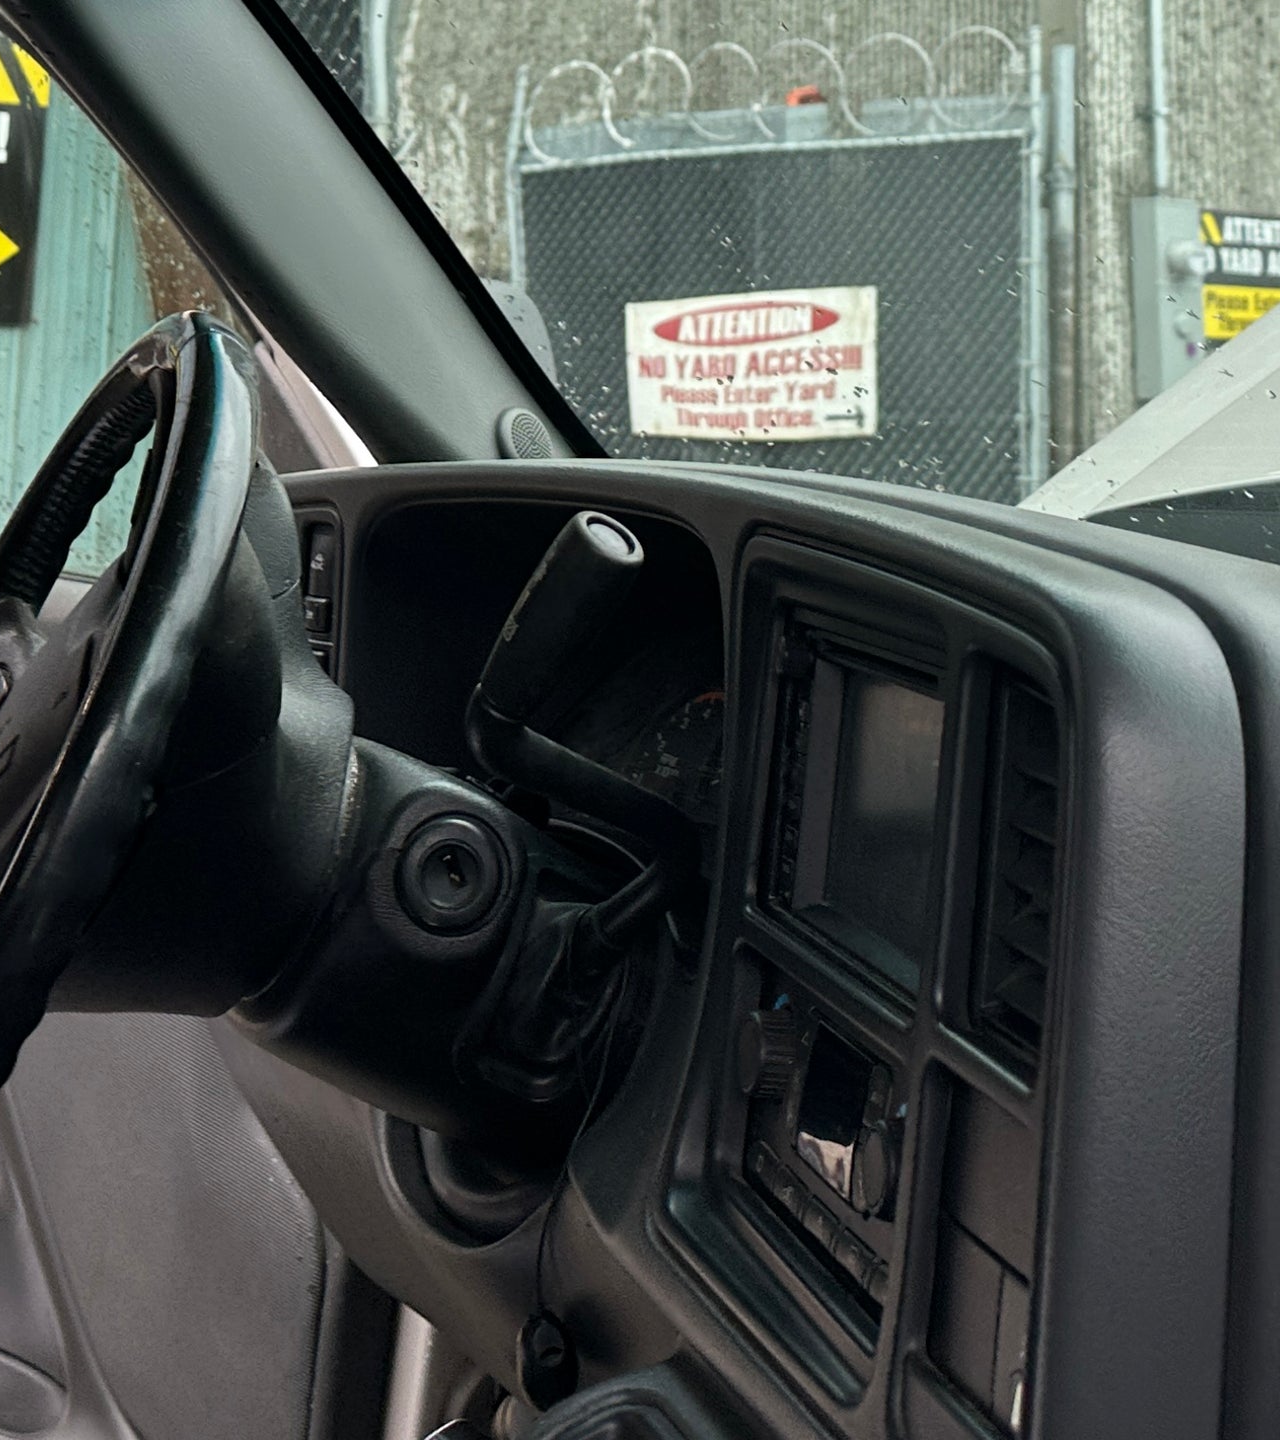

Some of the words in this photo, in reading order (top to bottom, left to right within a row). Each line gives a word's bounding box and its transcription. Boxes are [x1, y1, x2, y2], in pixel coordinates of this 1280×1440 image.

[678, 305, 809, 343] ATTENTION
[638, 355, 667, 379] NO
[675, 354, 736, 379] YARD
[661, 384, 719, 404] Please
[723, 385, 779, 404] Enter
[786, 378, 837, 402] Yard
